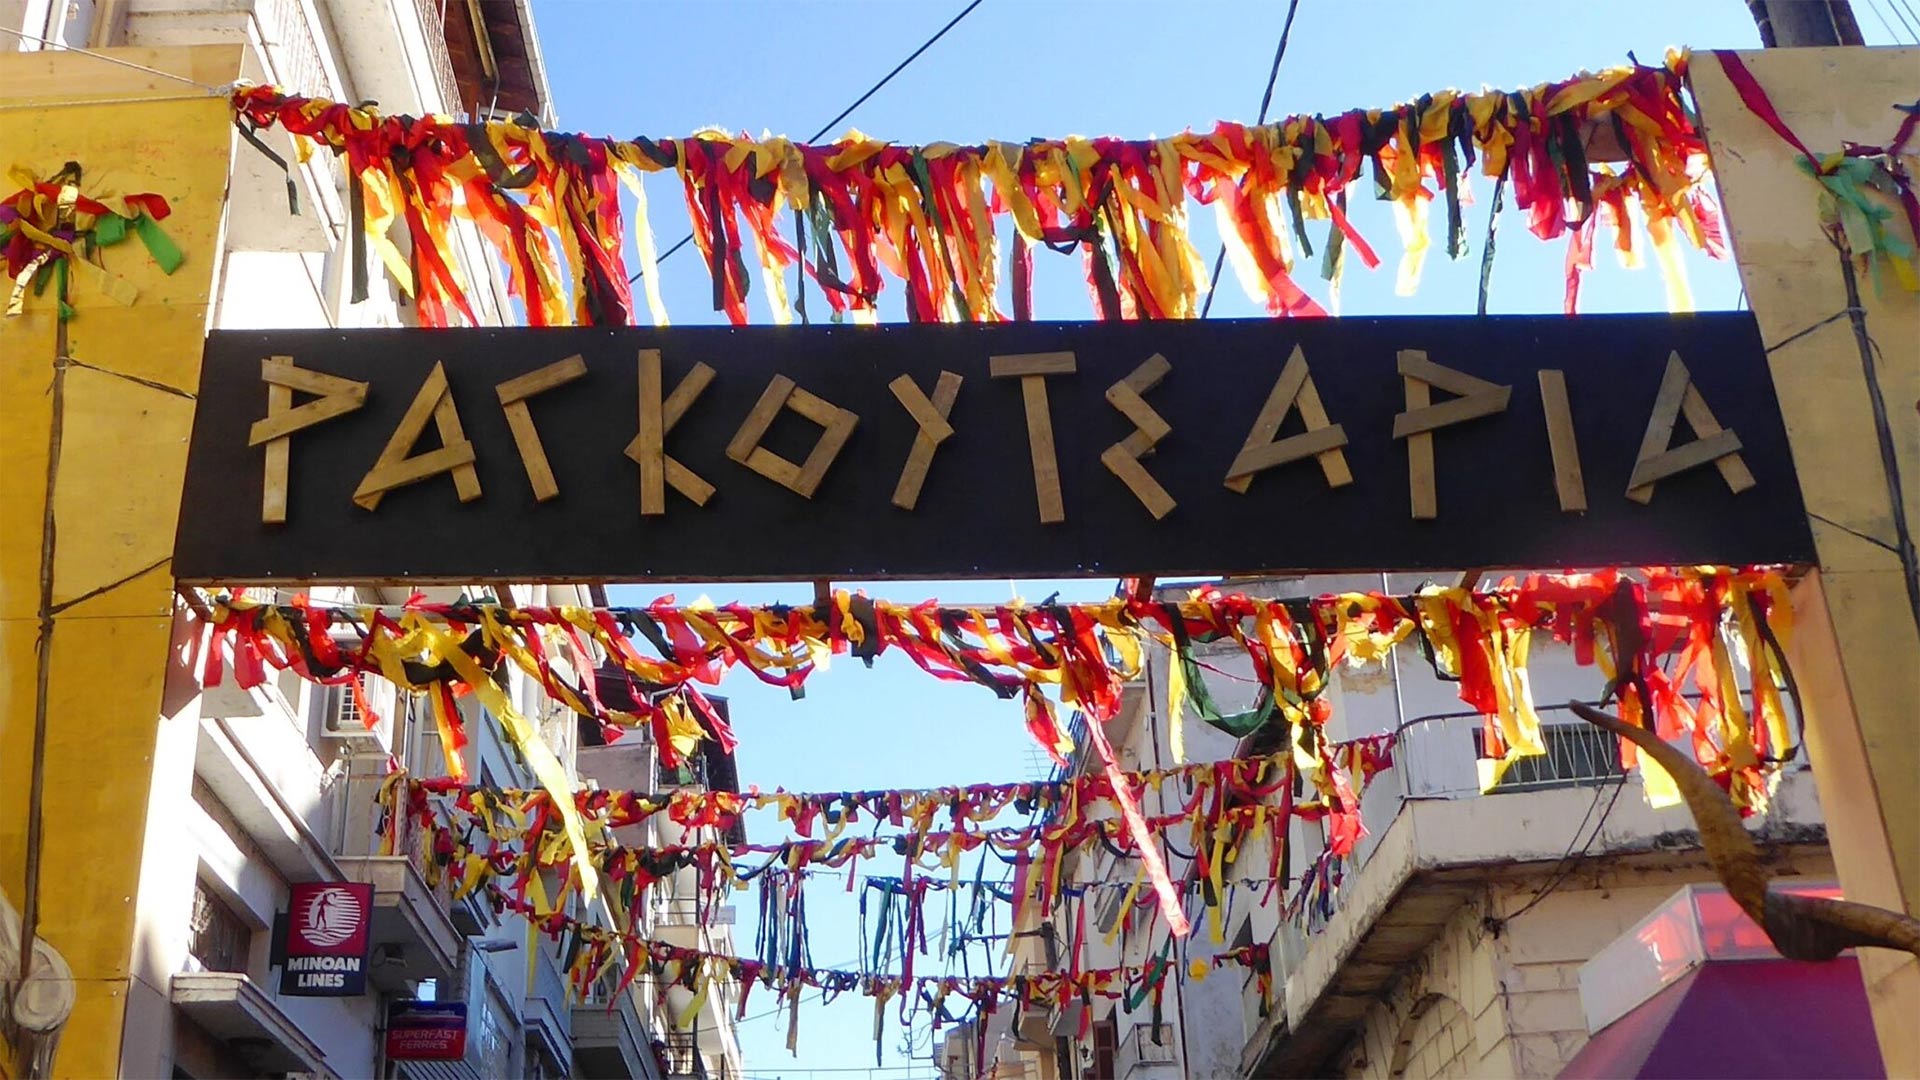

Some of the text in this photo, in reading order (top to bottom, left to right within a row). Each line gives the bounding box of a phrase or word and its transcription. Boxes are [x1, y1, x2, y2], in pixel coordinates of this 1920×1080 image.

[248, 343, 1757, 524] ΡΑΓΚΟΥΤΣΑΡΙΑ
[287, 956, 361, 972] MINOAN
[298, 973, 345, 988] LINES
[391, 1029, 459, 1040] SUPERFAST
[399, 1040, 449, 1050] FERRIES
